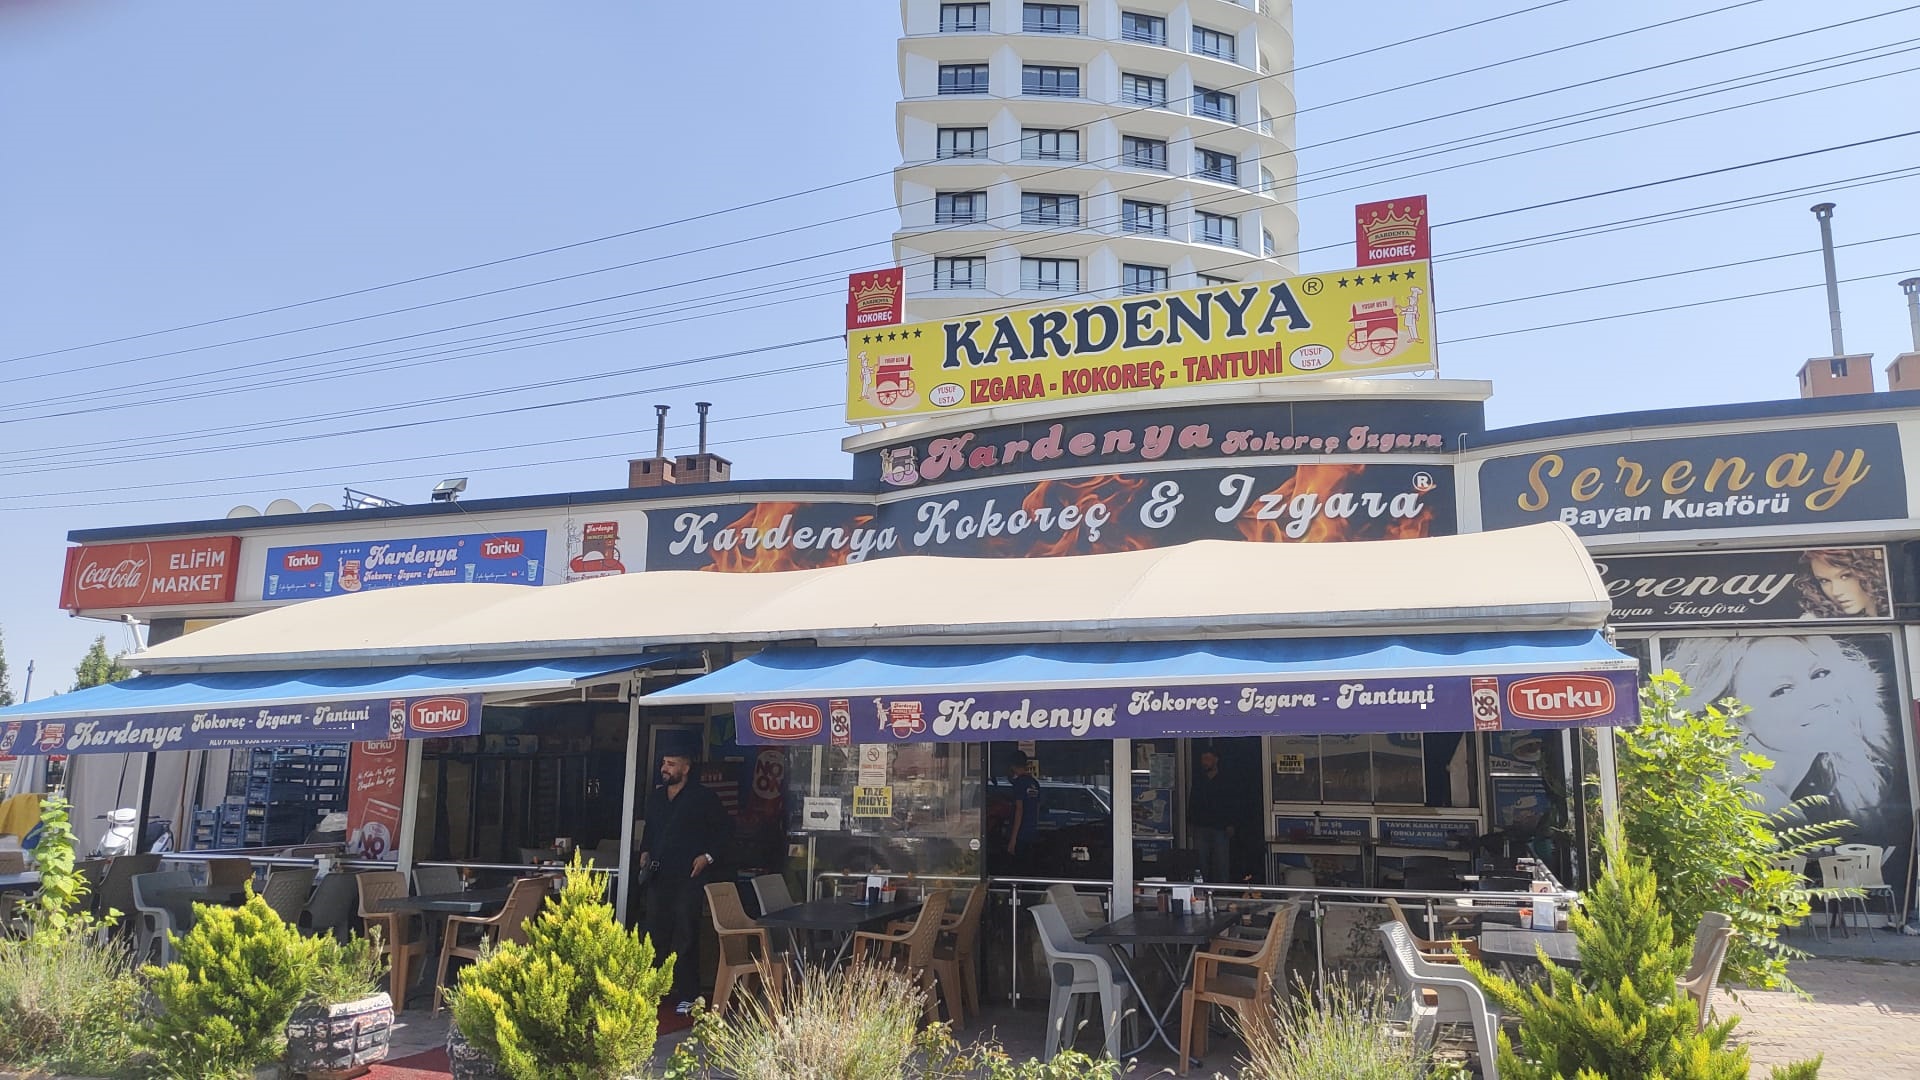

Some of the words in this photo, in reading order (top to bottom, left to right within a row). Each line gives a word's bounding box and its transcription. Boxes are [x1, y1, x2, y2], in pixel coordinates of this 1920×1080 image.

[1369, 244, 1416, 260] KOKOREÇ
[857, 310, 892, 324] KOKOREÇ
[943, 282, 1311, 369] KARDENYA
[1299, 348, 1323, 357] YUSUF
[970, 373, 1046, 404] IZGARA
[1062, 360, 1165, 389] KOKOREÇ
[1183, 342, 1283, 382] TANTUNİ
[1301, 358, 1322, 368] USTA
[938, 395, 955, 405] USTA
[919, 424, 1213, 480] Kardenya
[1221, 429, 1340, 454] Kokoreç
[1347, 426, 1443, 452] Izgara
[1517, 448, 1871, 512] Serenay
[669, 512, 898, 564] Kardenya
[913, 498, 1110, 547] Kokoreç
[1139, 480, 1184, 528] &
[1215, 473, 1424, 538] Izgara
[1559, 505, 1651, 528] Bayan
[1662, 493, 1790, 519] Kuaförü
[365, 544, 458, 569] Kardenya
[485, 541, 519, 555] Torku
[169, 548, 226, 570] ELİFİM
[287, 554, 318, 567] Torku
[79, 560, 147, 590] Coca-Cola
[151, 574, 223, 593] MARKET
[1610, 606, 1654, 618] ayan
[1664, 601, 1748, 618] Kuaförü
[1520, 686, 1603, 711] Torku
[417, 706, 462, 725] Torku
[758, 711, 814, 730] Torku
[932, 697, 1116, 737] Kardenya
[1127, 690, 1219, 715] Kokoreç
[1238, 687, 1317, 713] Izgara
[1336, 684, 1436, 709] Tantuni
[66, 720, 183, 749] Kardenya
[191, 713, 246, 733] Kokoreç
[256, 709, 302, 731] Izgara
[312, 705, 370, 726] Tantuni
[862, 787, 884, 796] TAZE
